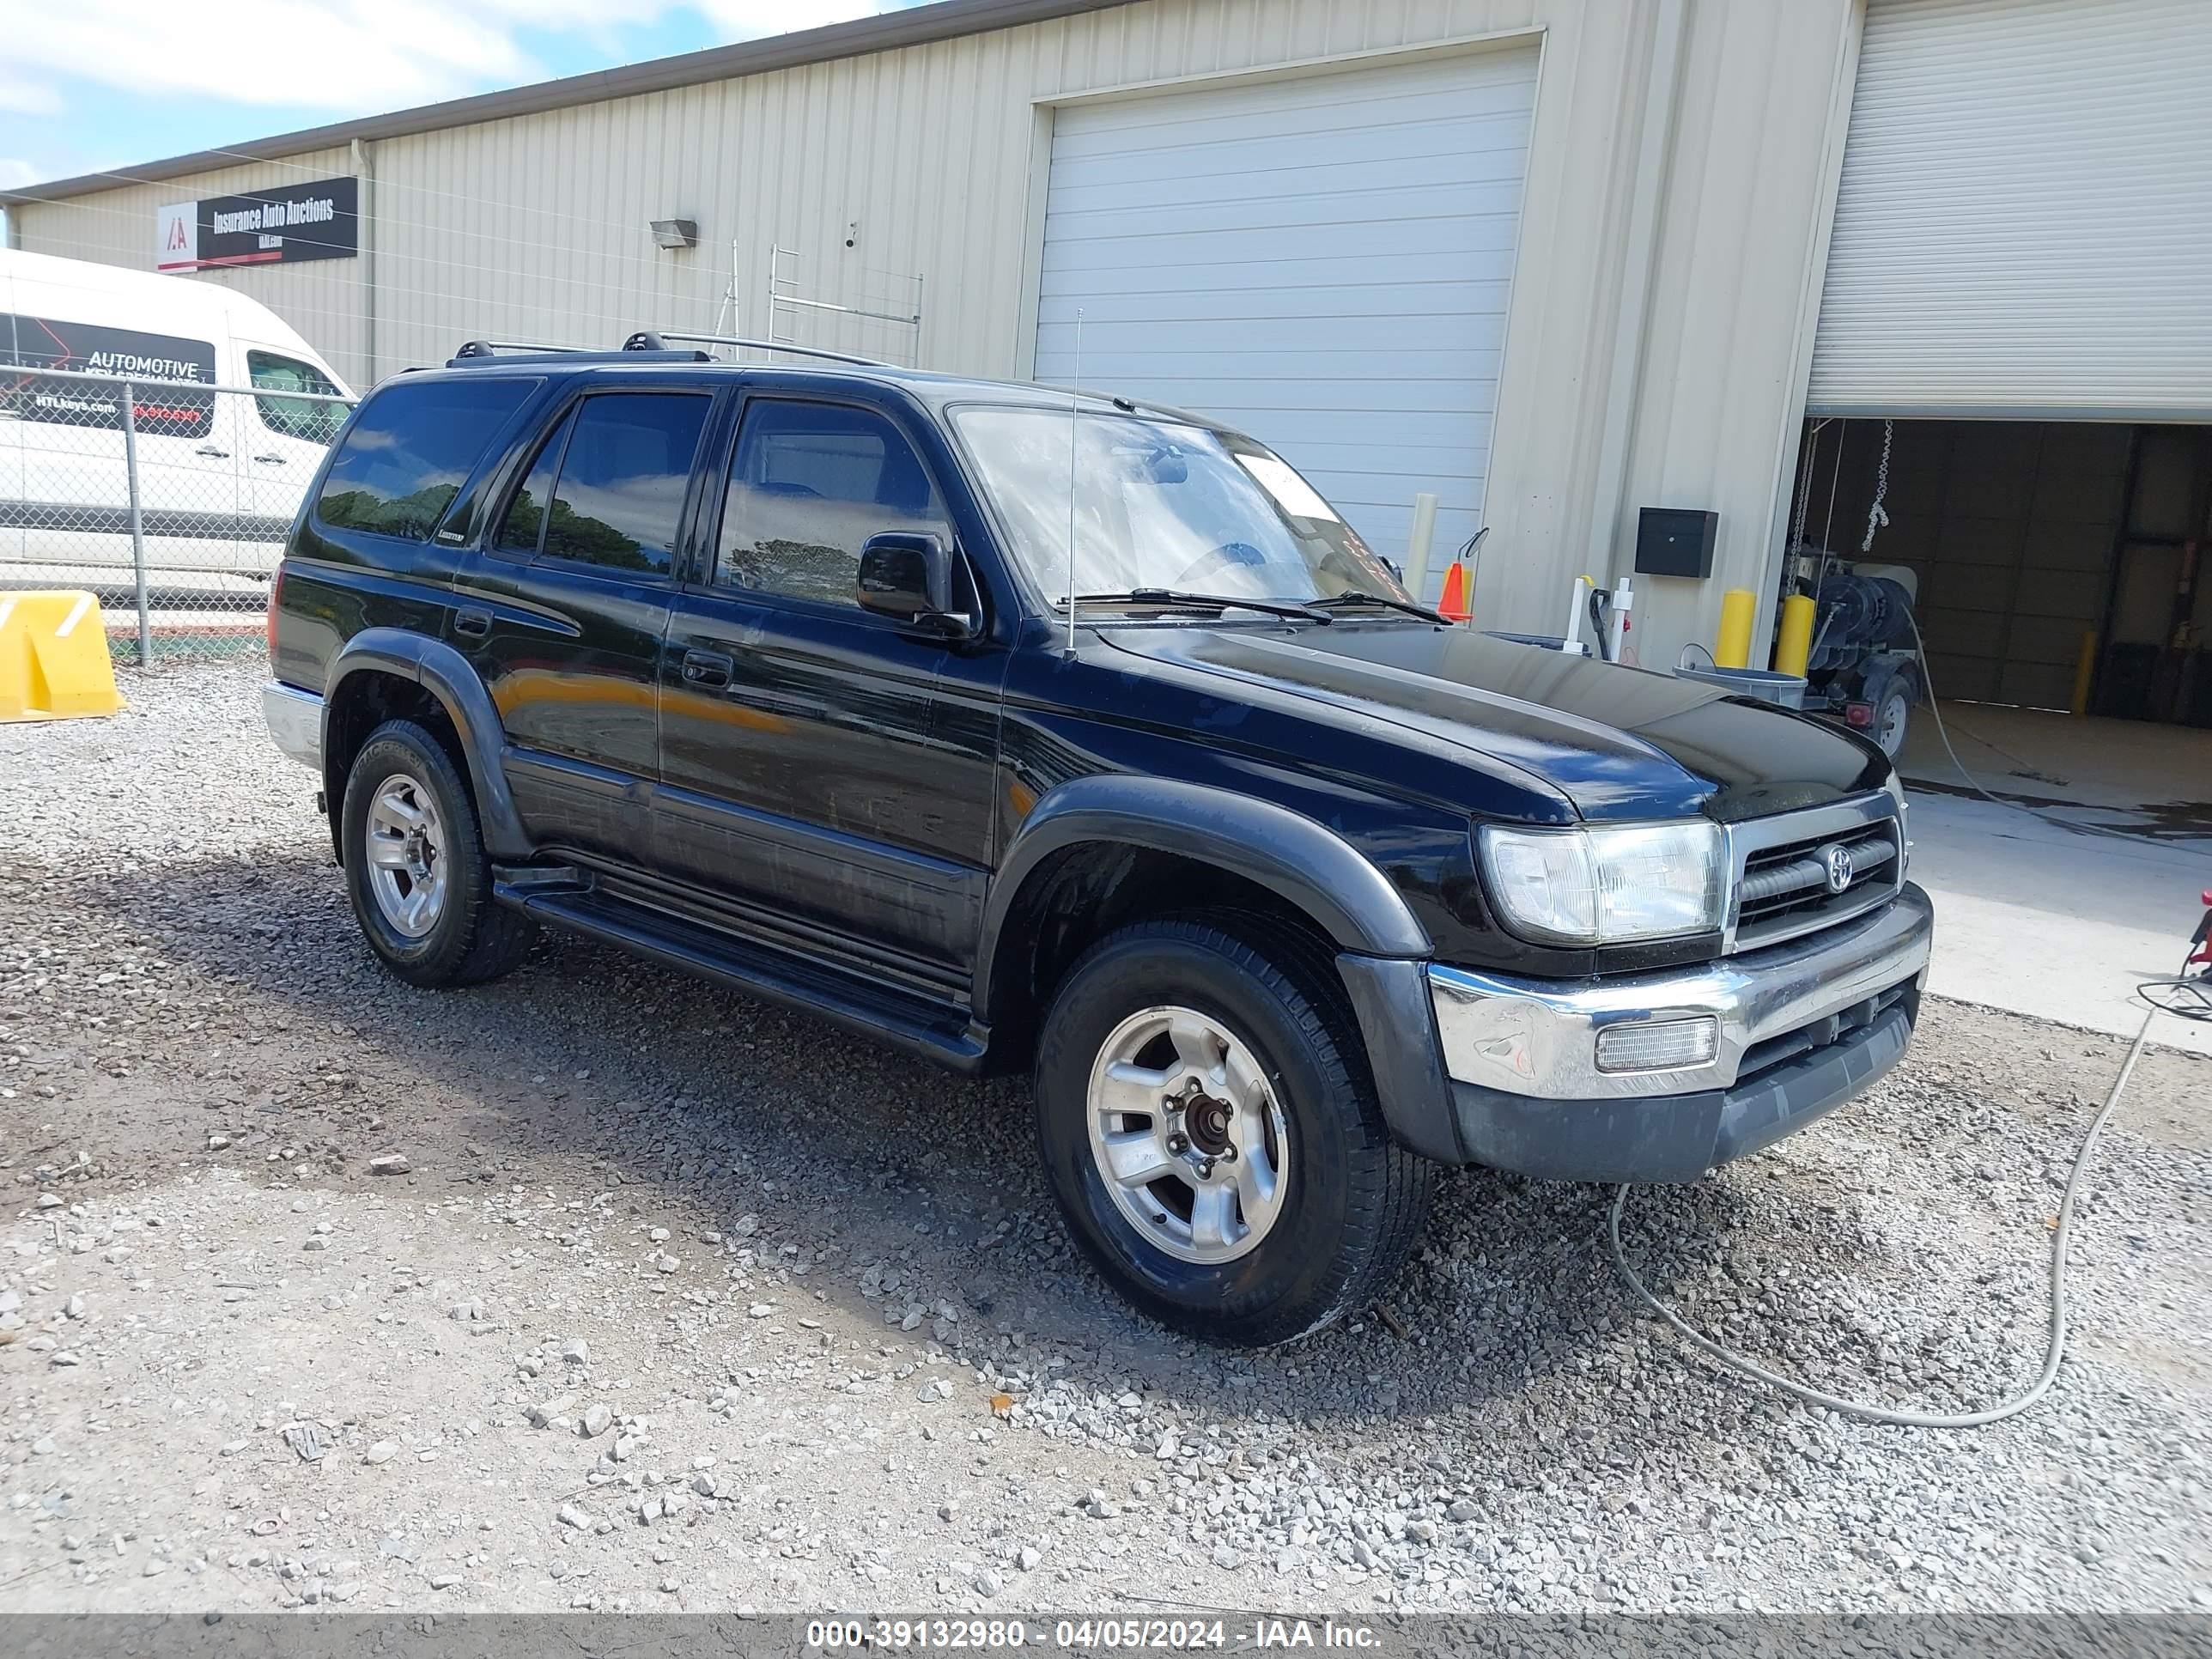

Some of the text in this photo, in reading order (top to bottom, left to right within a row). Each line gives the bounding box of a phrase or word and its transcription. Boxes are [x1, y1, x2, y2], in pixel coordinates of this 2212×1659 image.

[214, 197, 334, 234] Insurance Auto Auctions
[88, 350, 199, 379] AUTOMOTIVE
[35, 395, 116, 414] HTLkeys.com
